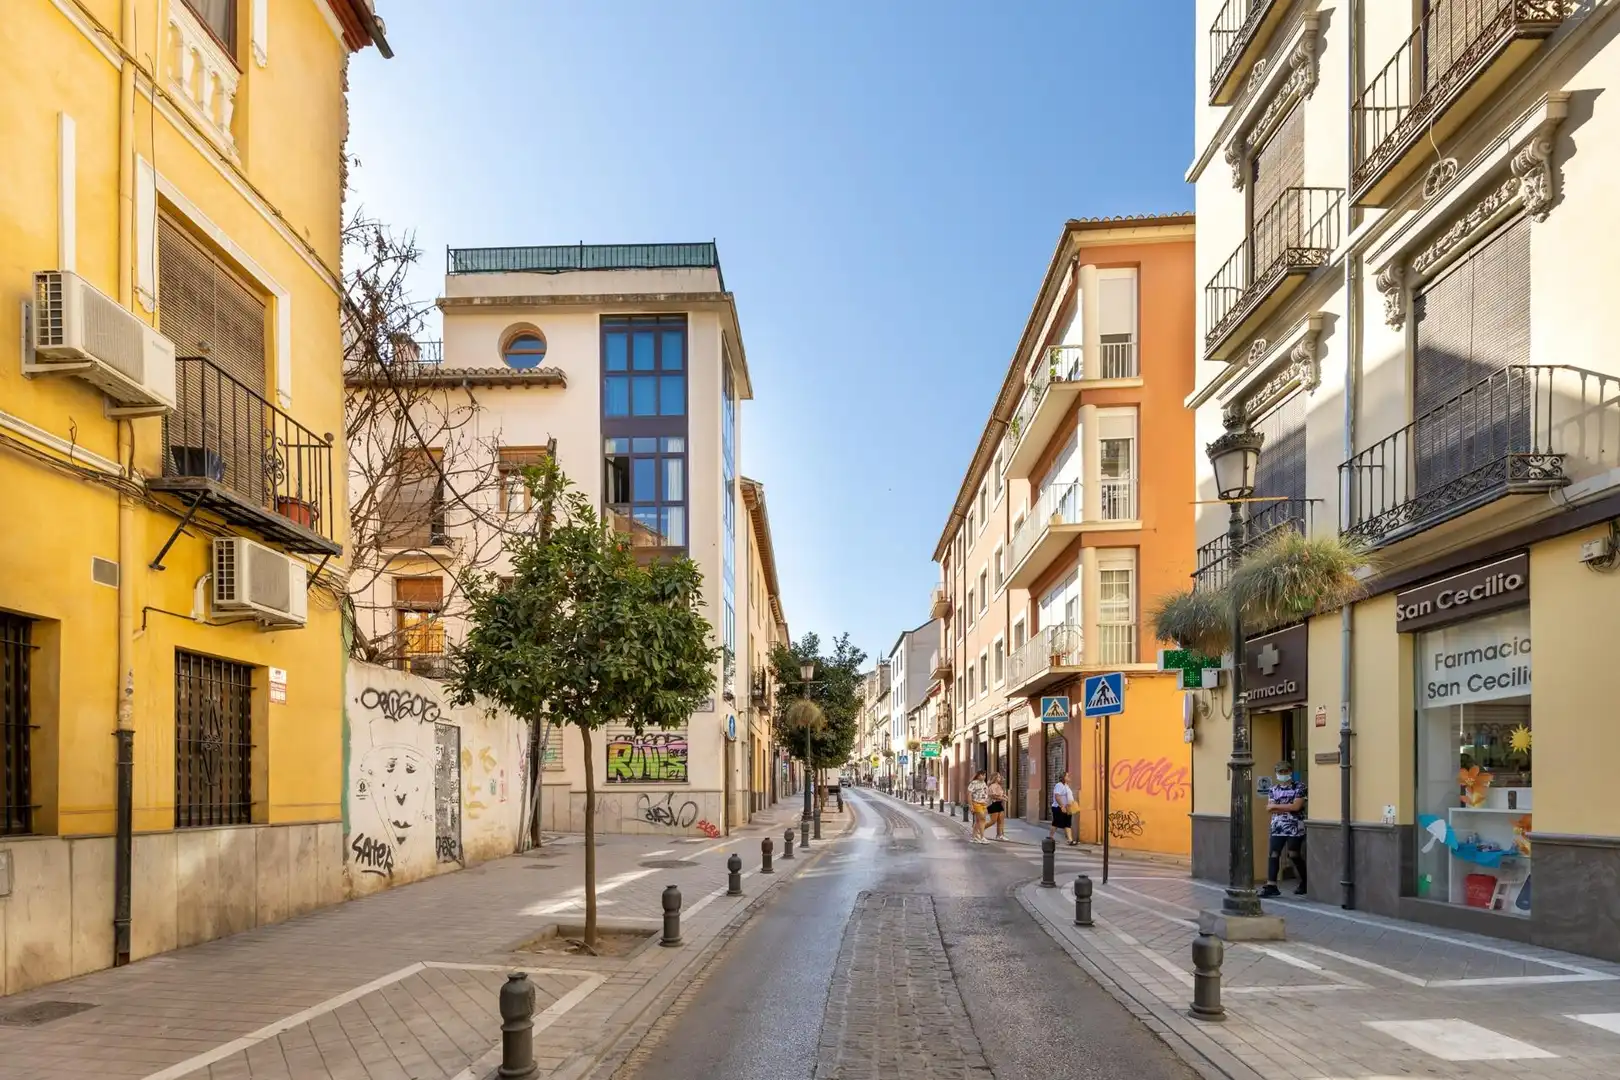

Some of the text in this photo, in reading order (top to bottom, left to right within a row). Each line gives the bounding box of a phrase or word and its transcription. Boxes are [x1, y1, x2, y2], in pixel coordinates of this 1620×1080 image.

[1396, 572, 1522, 622] San Cecilio
[1246, 679, 1296, 700] armacia
[1427, 666, 1531, 699] San Cecili
